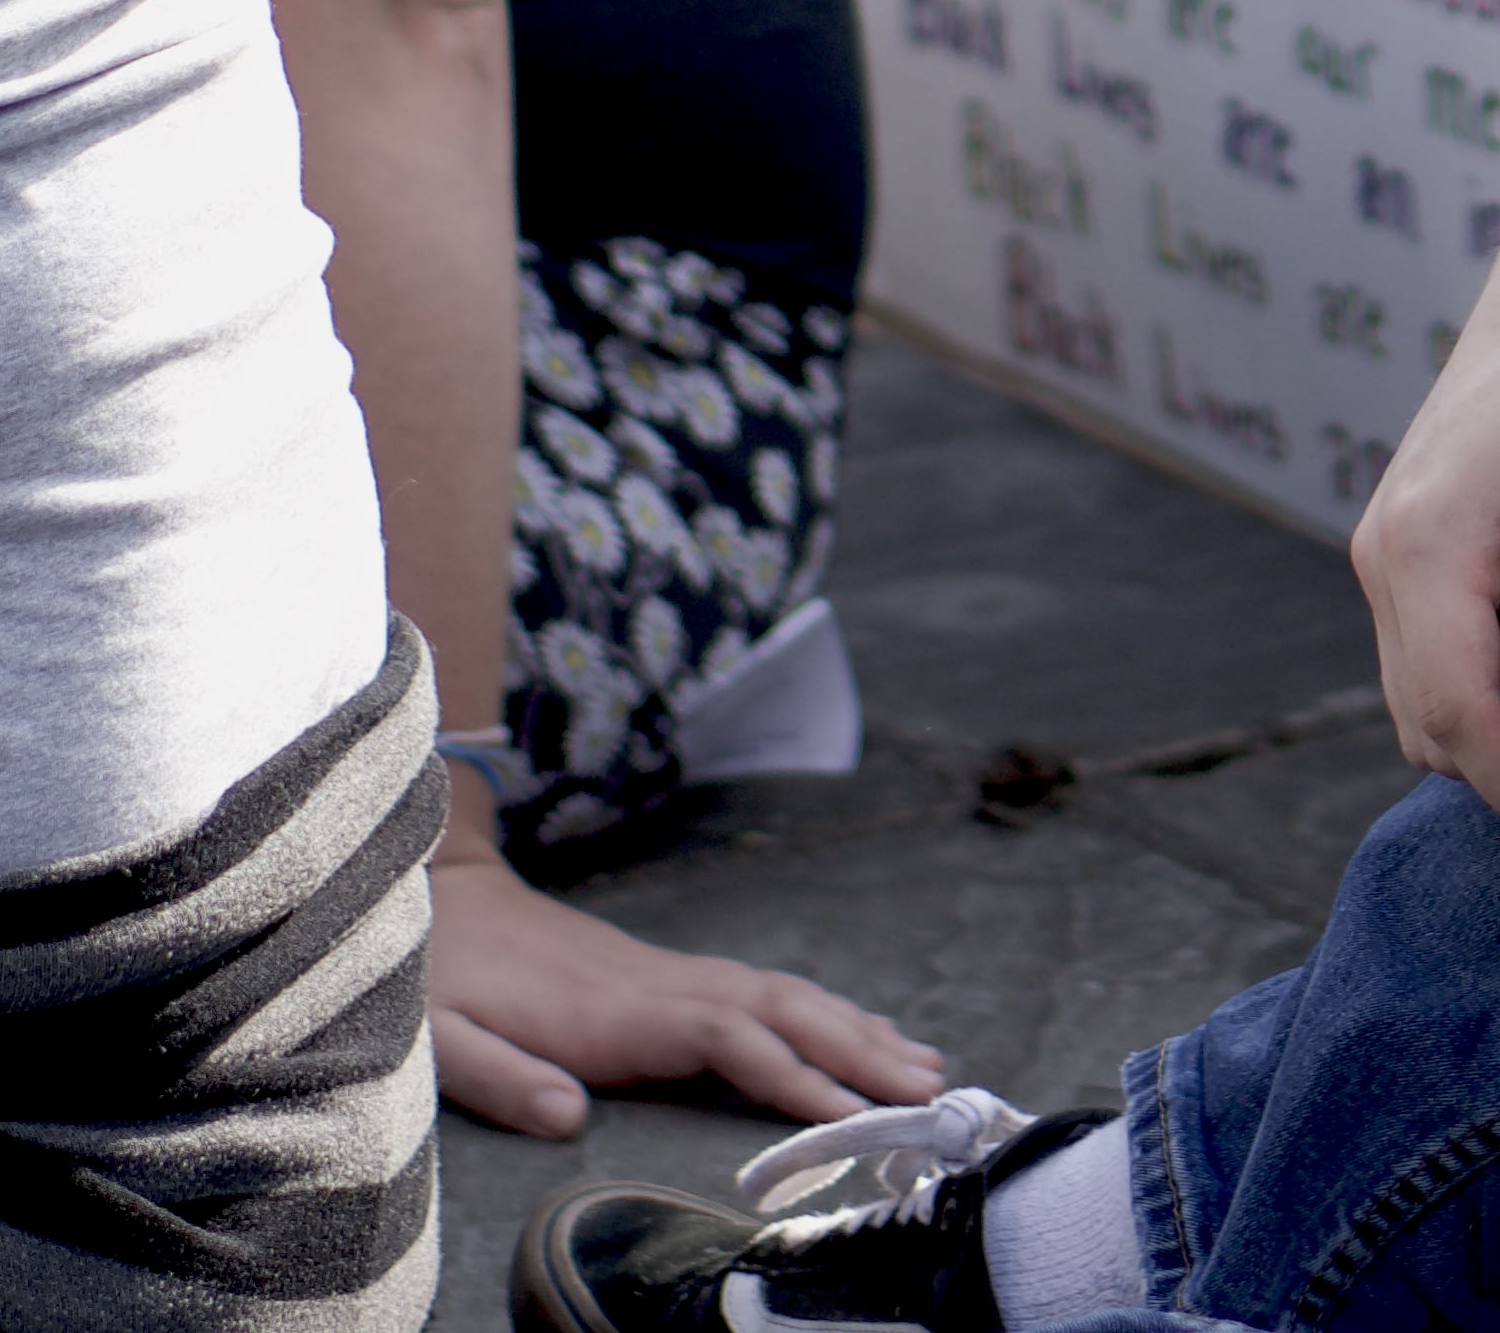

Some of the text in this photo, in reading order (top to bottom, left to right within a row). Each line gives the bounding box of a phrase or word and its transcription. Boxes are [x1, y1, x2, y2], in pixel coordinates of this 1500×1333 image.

[1053, 13, 1154, 144] Lives
[1223, 99, 1296, 189] are
[1356, 156, 1417, 240] an
[1296, 27, 1376, 95] our
[966, 99, 1088, 233] Black
[1151, 181, 1268, 308] Lives
[1315, 282, 1386, 355] are
[1006, 240, 1123, 385] Black
[1154, 324, 1285, 460] Lives
